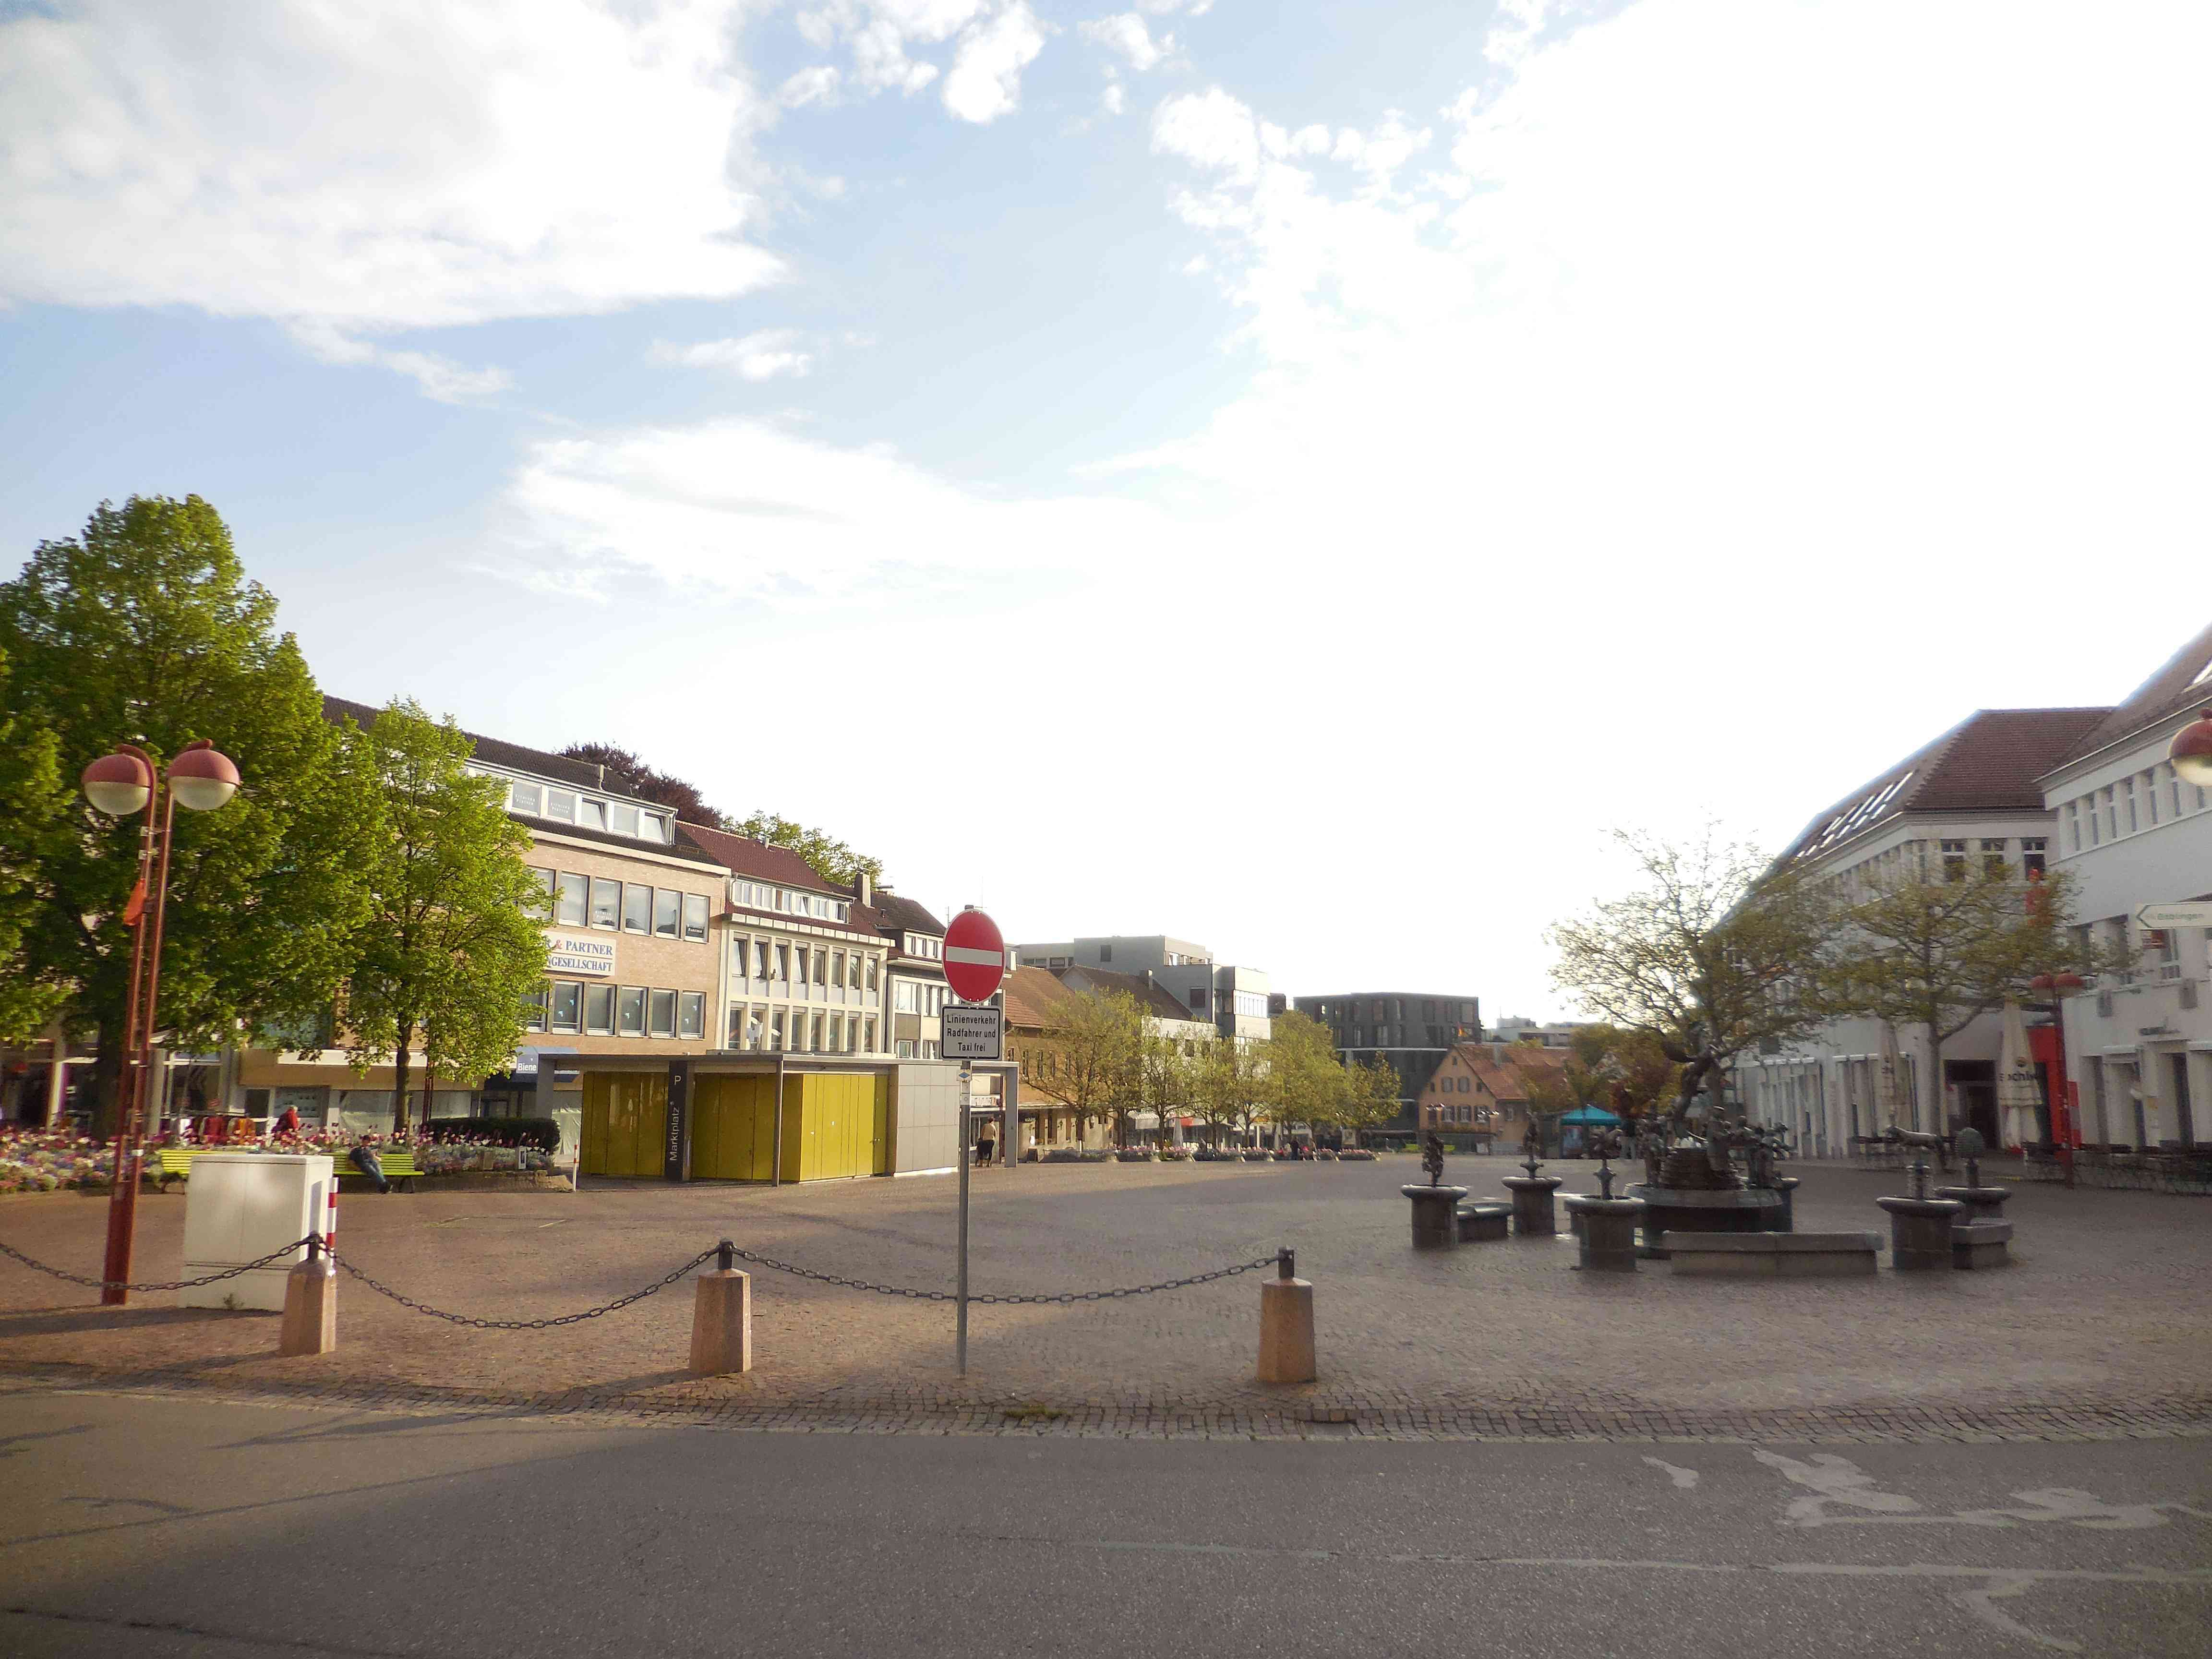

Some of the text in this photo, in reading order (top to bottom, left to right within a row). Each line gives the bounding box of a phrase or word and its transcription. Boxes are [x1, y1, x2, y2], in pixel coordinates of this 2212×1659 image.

[556, 939, 562, 950] &
[565, 940, 613, 956] PARTNER
[947, 1014, 996, 1024] Linienverkehr
[947, 1028, 996, 1038] Radfahrer und
[958, 1042, 986, 1052] Taxi frei
[518, 1063, 537, 1071] Biene
[674, 1075, 682, 1085] P
[669, 1107, 680, 1161] Marktplatz
